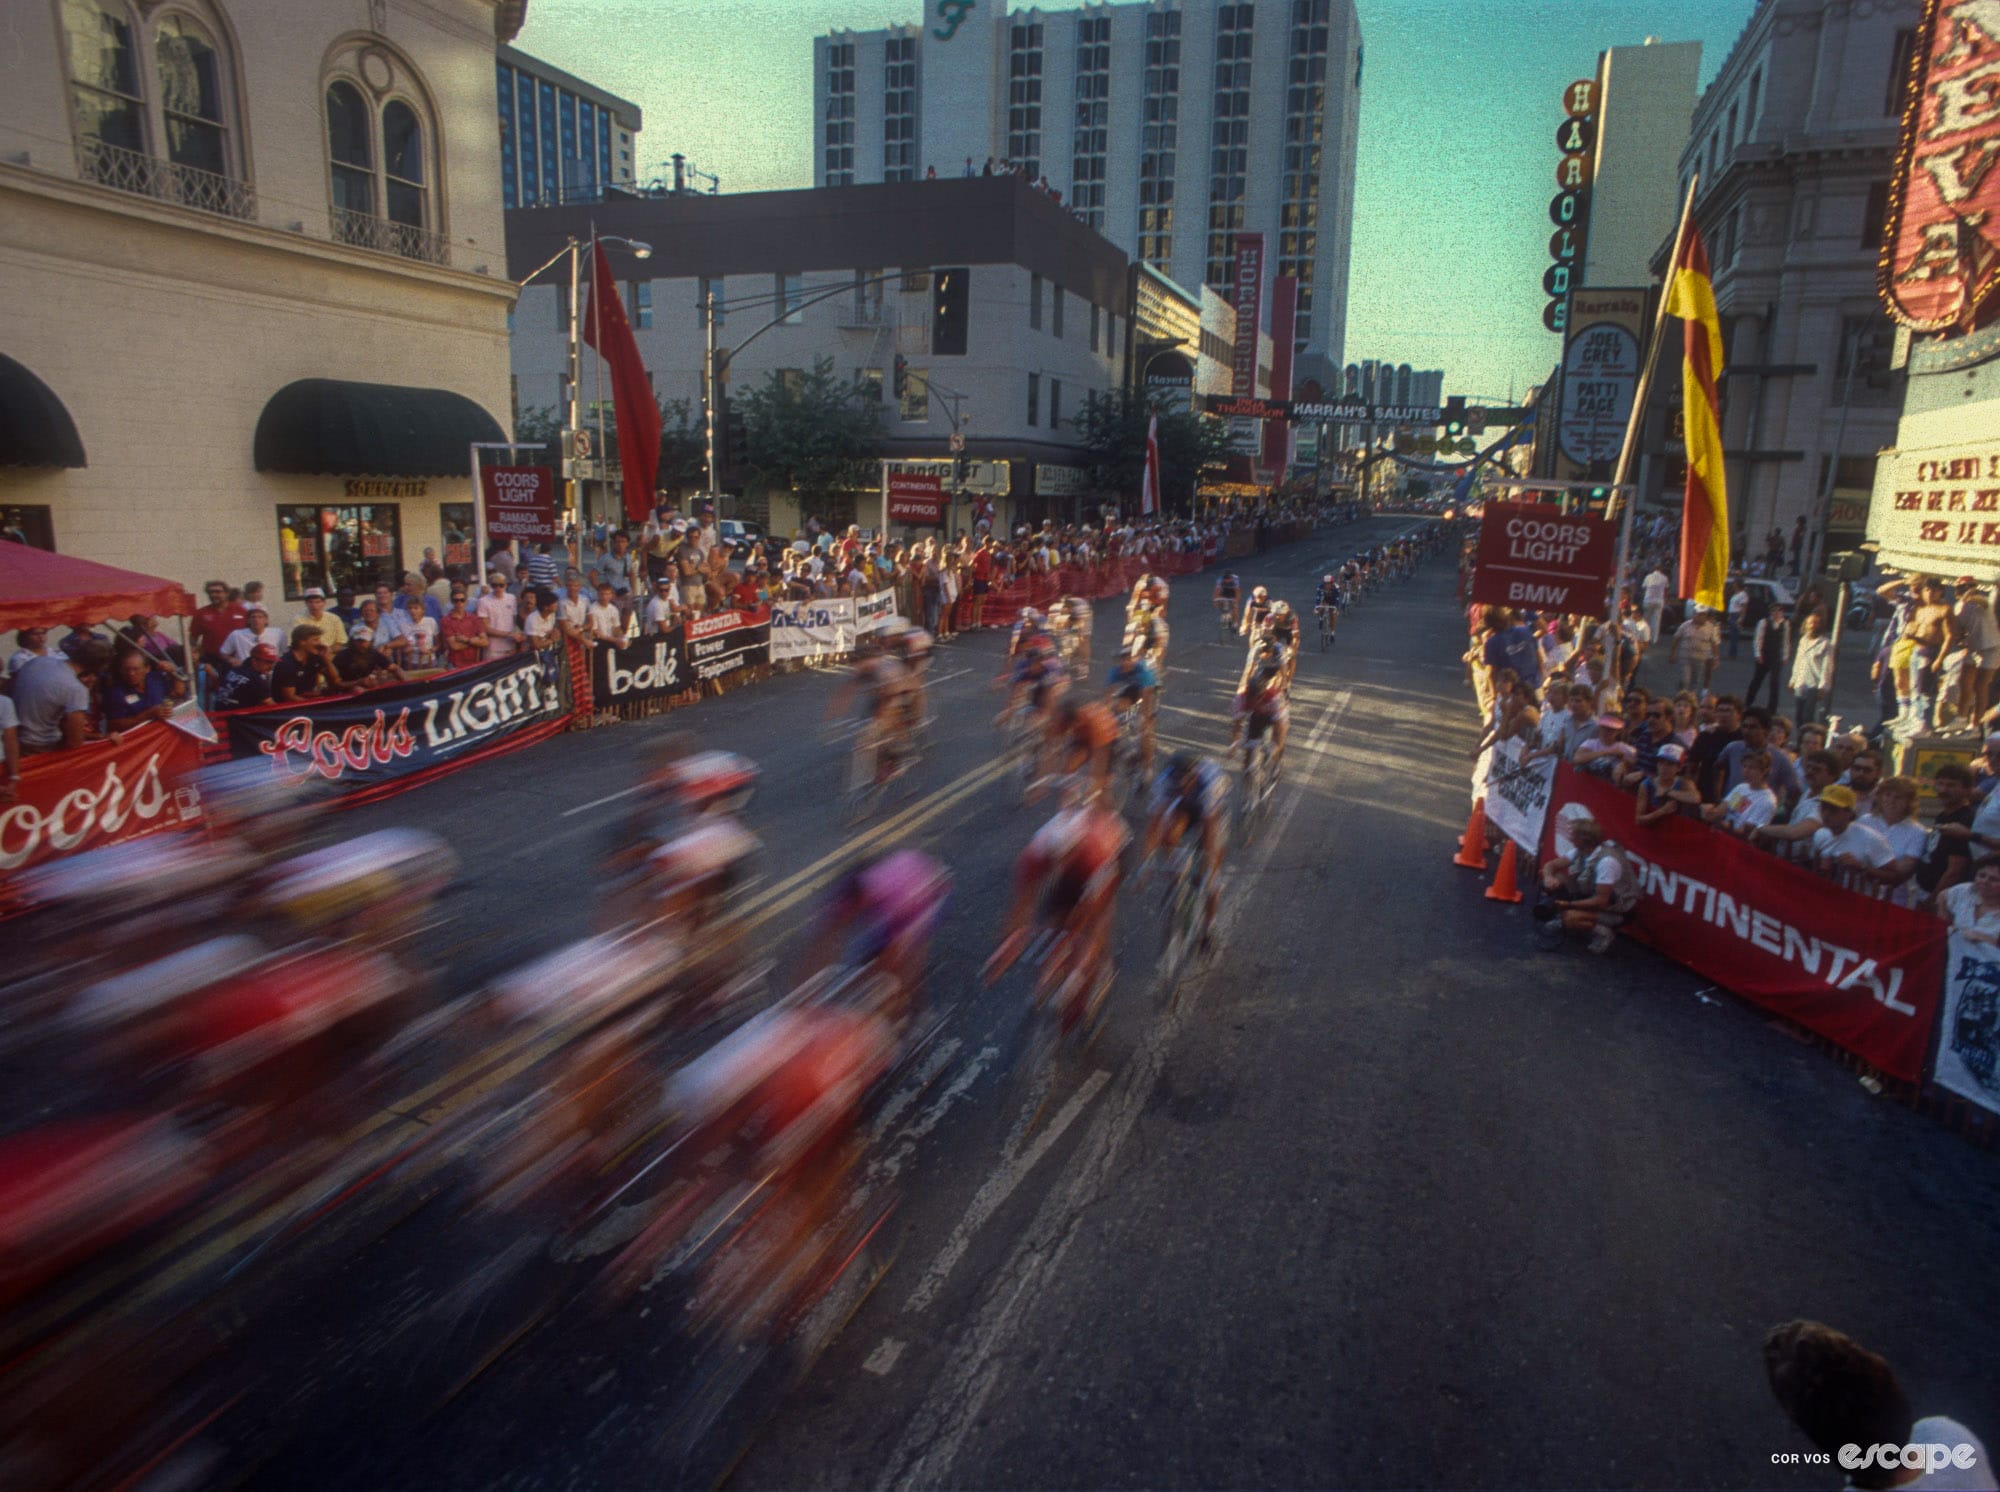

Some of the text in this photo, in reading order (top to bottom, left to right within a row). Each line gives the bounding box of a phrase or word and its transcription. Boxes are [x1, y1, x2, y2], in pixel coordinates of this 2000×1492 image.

[1585, 332, 1622, 347] JOEL
[1582, 348, 1621, 363] GREY
[1578, 382, 1619, 397] PATTI
[1294, 403, 1368, 418] HARRAH'S
[1375, 404, 1441, 421] SALUTES
[939, 463, 981, 479] GT
[494, 472, 540, 488] COORS
[890, 481, 938, 492] CONTINENTAL
[498, 487, 536, 503] LIGHT
[499, 511, 540, 523] RAMADA
[488, 521, 552, 536] RENAISSANCE
[1506, 518, 1592, 545] COORS
[1509, 539, 1581, 564] LIGHT
[1508, 581, 1569, 605] BMW
[691, 612, 743, 635] HONDA
[694, 638, 725, 656] Power
[697, 653, 745, 679] Equipment
[258, 706, 418, 786] Coors
[1625, 850, 1916, 1017] ONTINENTAL
